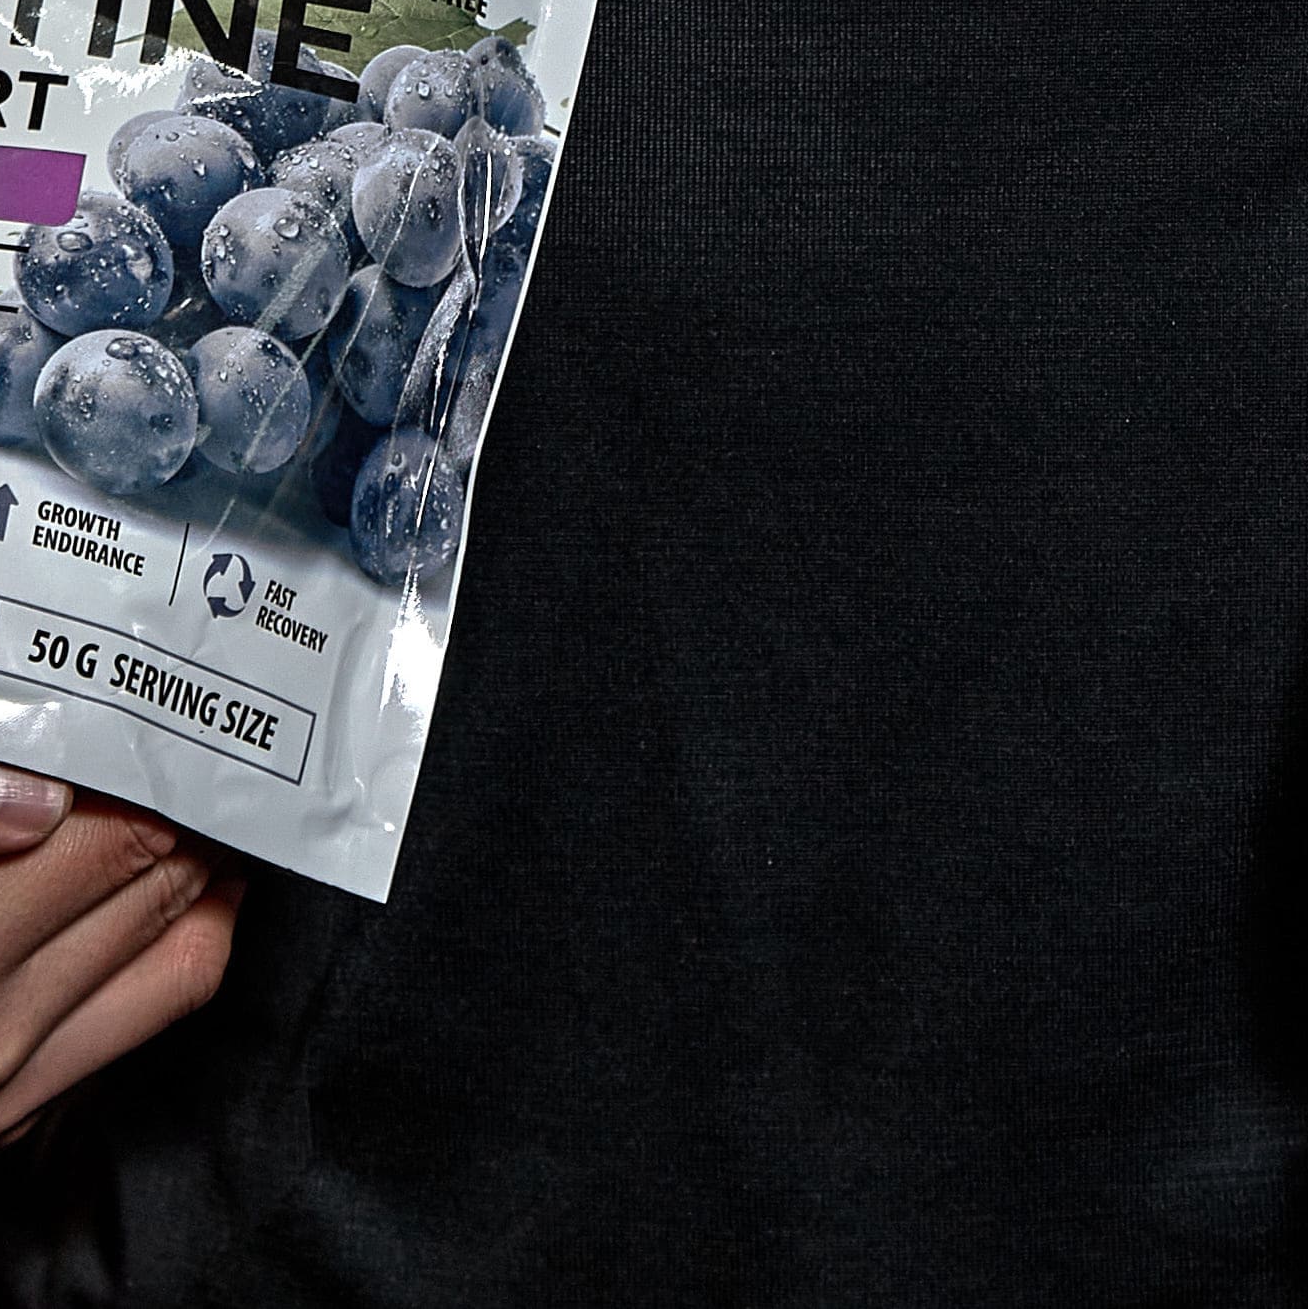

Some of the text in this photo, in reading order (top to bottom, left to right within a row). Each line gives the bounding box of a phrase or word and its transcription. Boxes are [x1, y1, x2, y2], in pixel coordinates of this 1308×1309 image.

[37, 499, 122, 542] GROWTH
[31, 524, 146, 577] ENDURANCE
[263, 579, 298, 612] FAST
[254, 604, 329, 654] RECOVERY
[27, 628, 279, 752] 50 G SERVING SIZE
